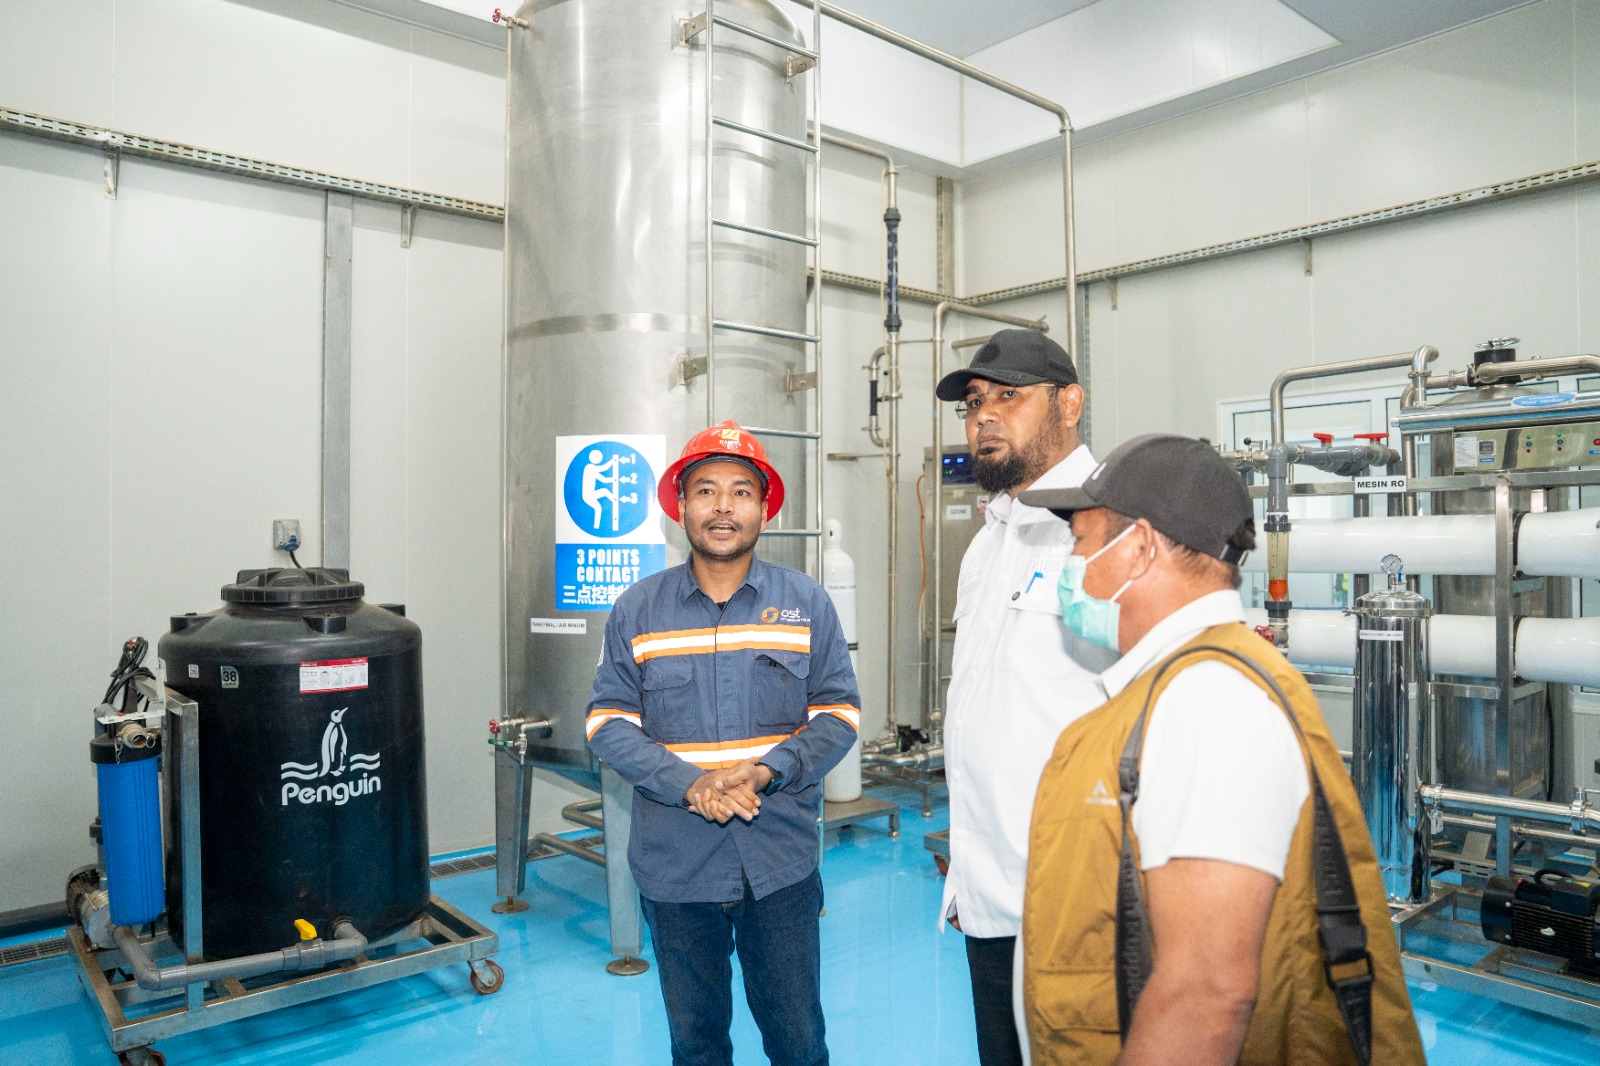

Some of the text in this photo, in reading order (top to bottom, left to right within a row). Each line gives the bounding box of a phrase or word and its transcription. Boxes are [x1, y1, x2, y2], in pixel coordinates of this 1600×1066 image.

[630, 453, 636, 465] 1
[630, 472, 638, 485] 2
[630, 492, 638, 505] 3
[577, 548, 640, 565] 3 POINTS
[577, 566, 640, 582] CONTACT
[780, 607, 801, 619] ost
[222, 671, 238, 682] 38
[281, 773, 381, 805] Penguin
